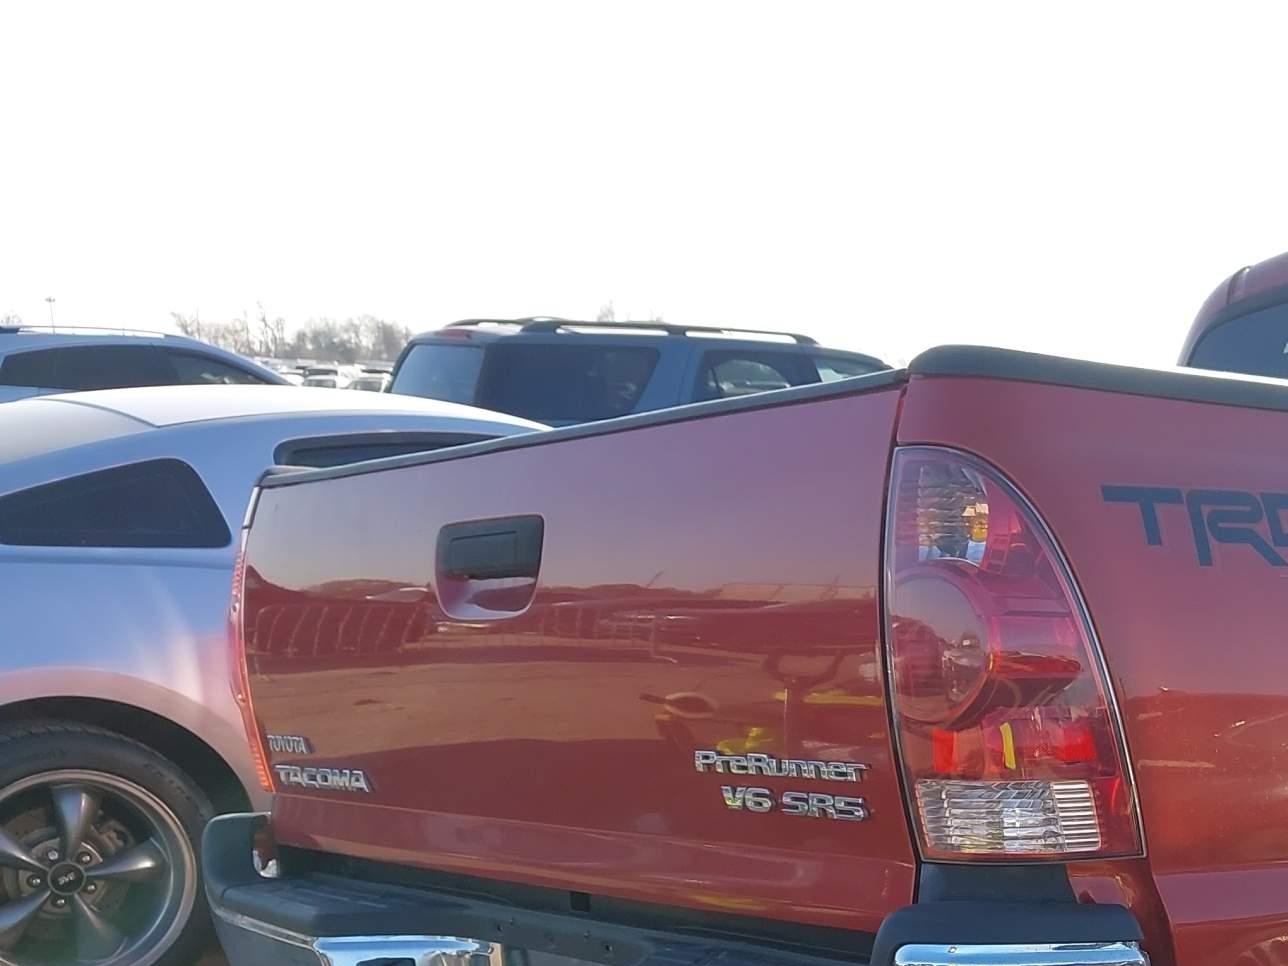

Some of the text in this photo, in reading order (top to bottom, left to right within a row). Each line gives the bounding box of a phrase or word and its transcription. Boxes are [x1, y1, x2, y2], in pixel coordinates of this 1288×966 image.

[267, 734, 311, 754] TOYOTA
[274, 764, 370, 793] TACOMA
[694, 750, 871, 782] PreRunner
[721, 785, 869, 822] V6 SR5
